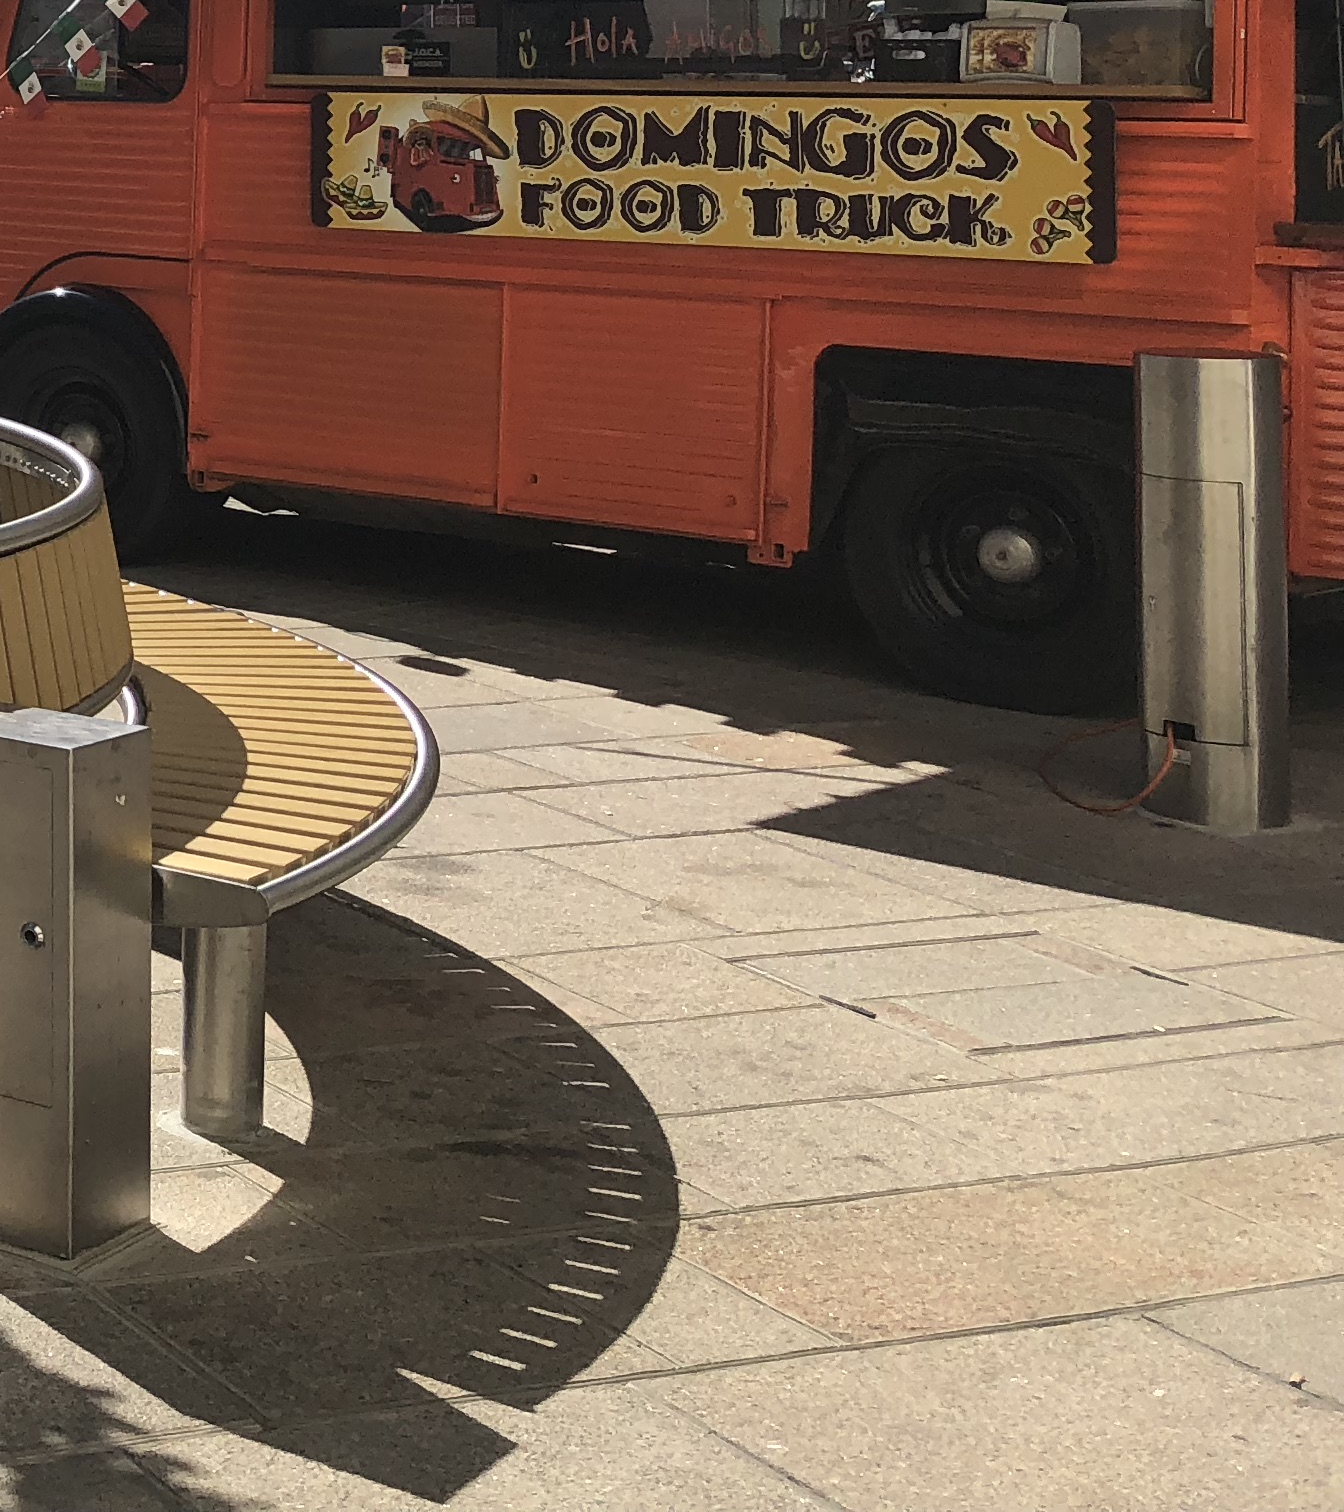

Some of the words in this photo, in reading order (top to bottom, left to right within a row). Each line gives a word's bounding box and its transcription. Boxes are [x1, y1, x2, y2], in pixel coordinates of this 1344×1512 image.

[514, 105, 1018, 182] DOMINGOS
[519, 176, 722, 234] FOOD
[742, 188, 1014, 246] TRUCK
